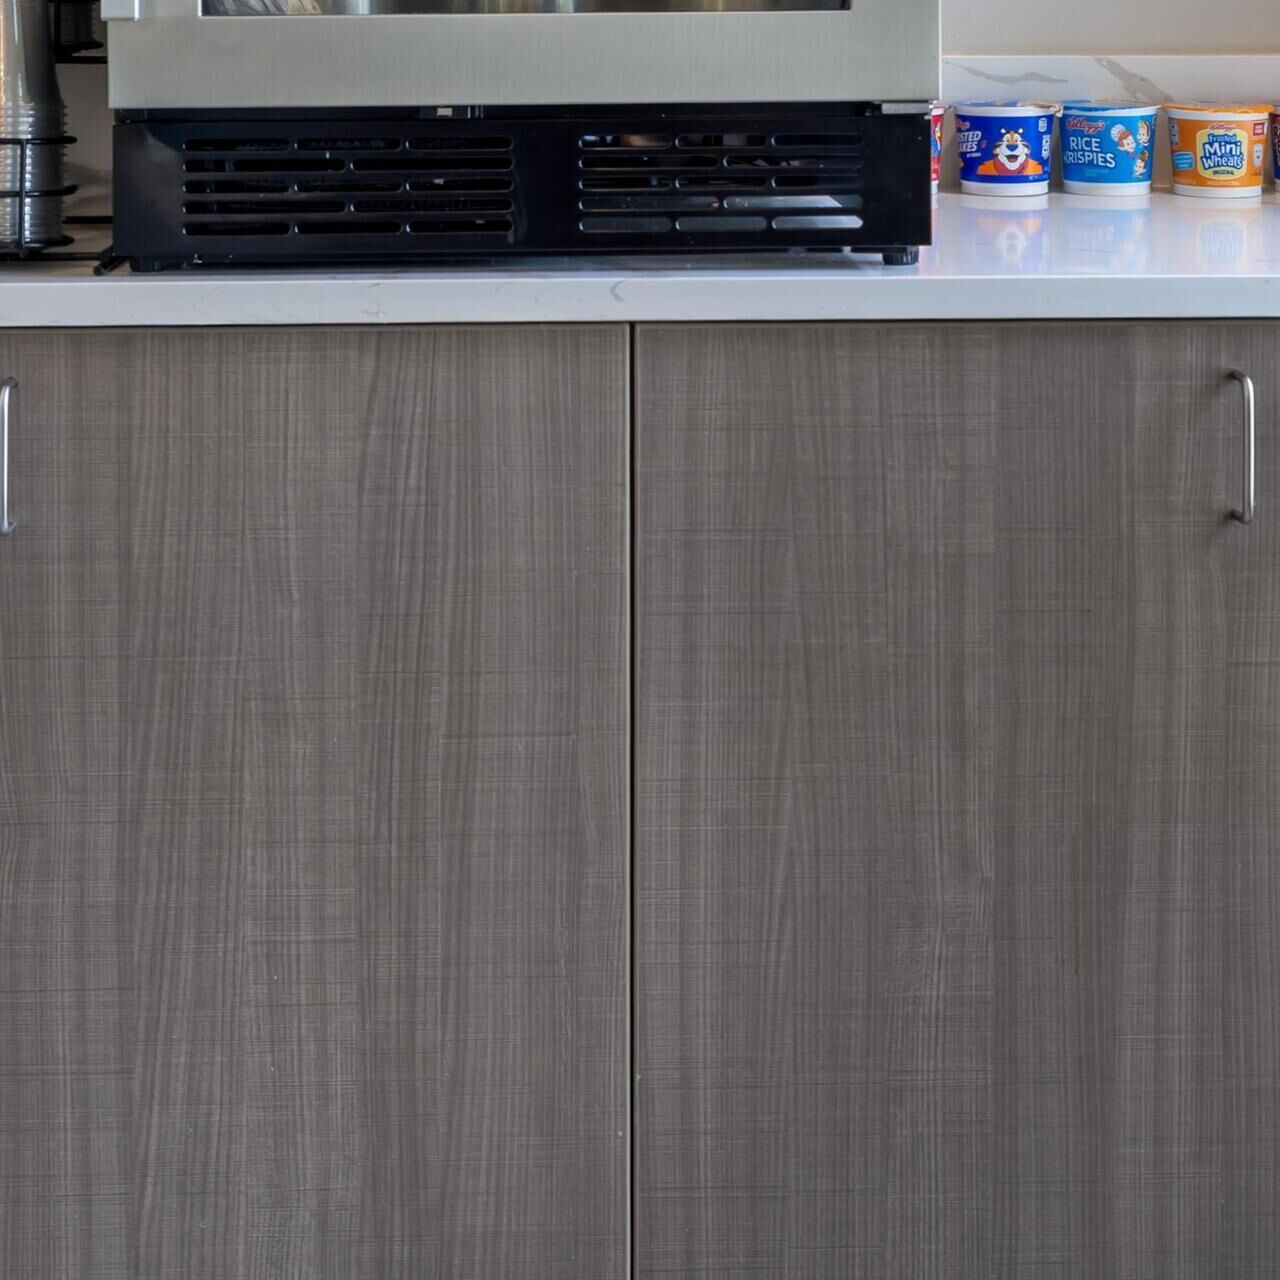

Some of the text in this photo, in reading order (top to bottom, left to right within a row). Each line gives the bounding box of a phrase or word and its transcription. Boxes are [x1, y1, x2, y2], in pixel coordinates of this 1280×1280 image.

[1066, 116, 1105, 134] Kellogg's
[1070, 137, 1101, 151] RICE
[1205, 142, 1241, 157] Mini
[1202, 154, 1243, 169] Wheats
